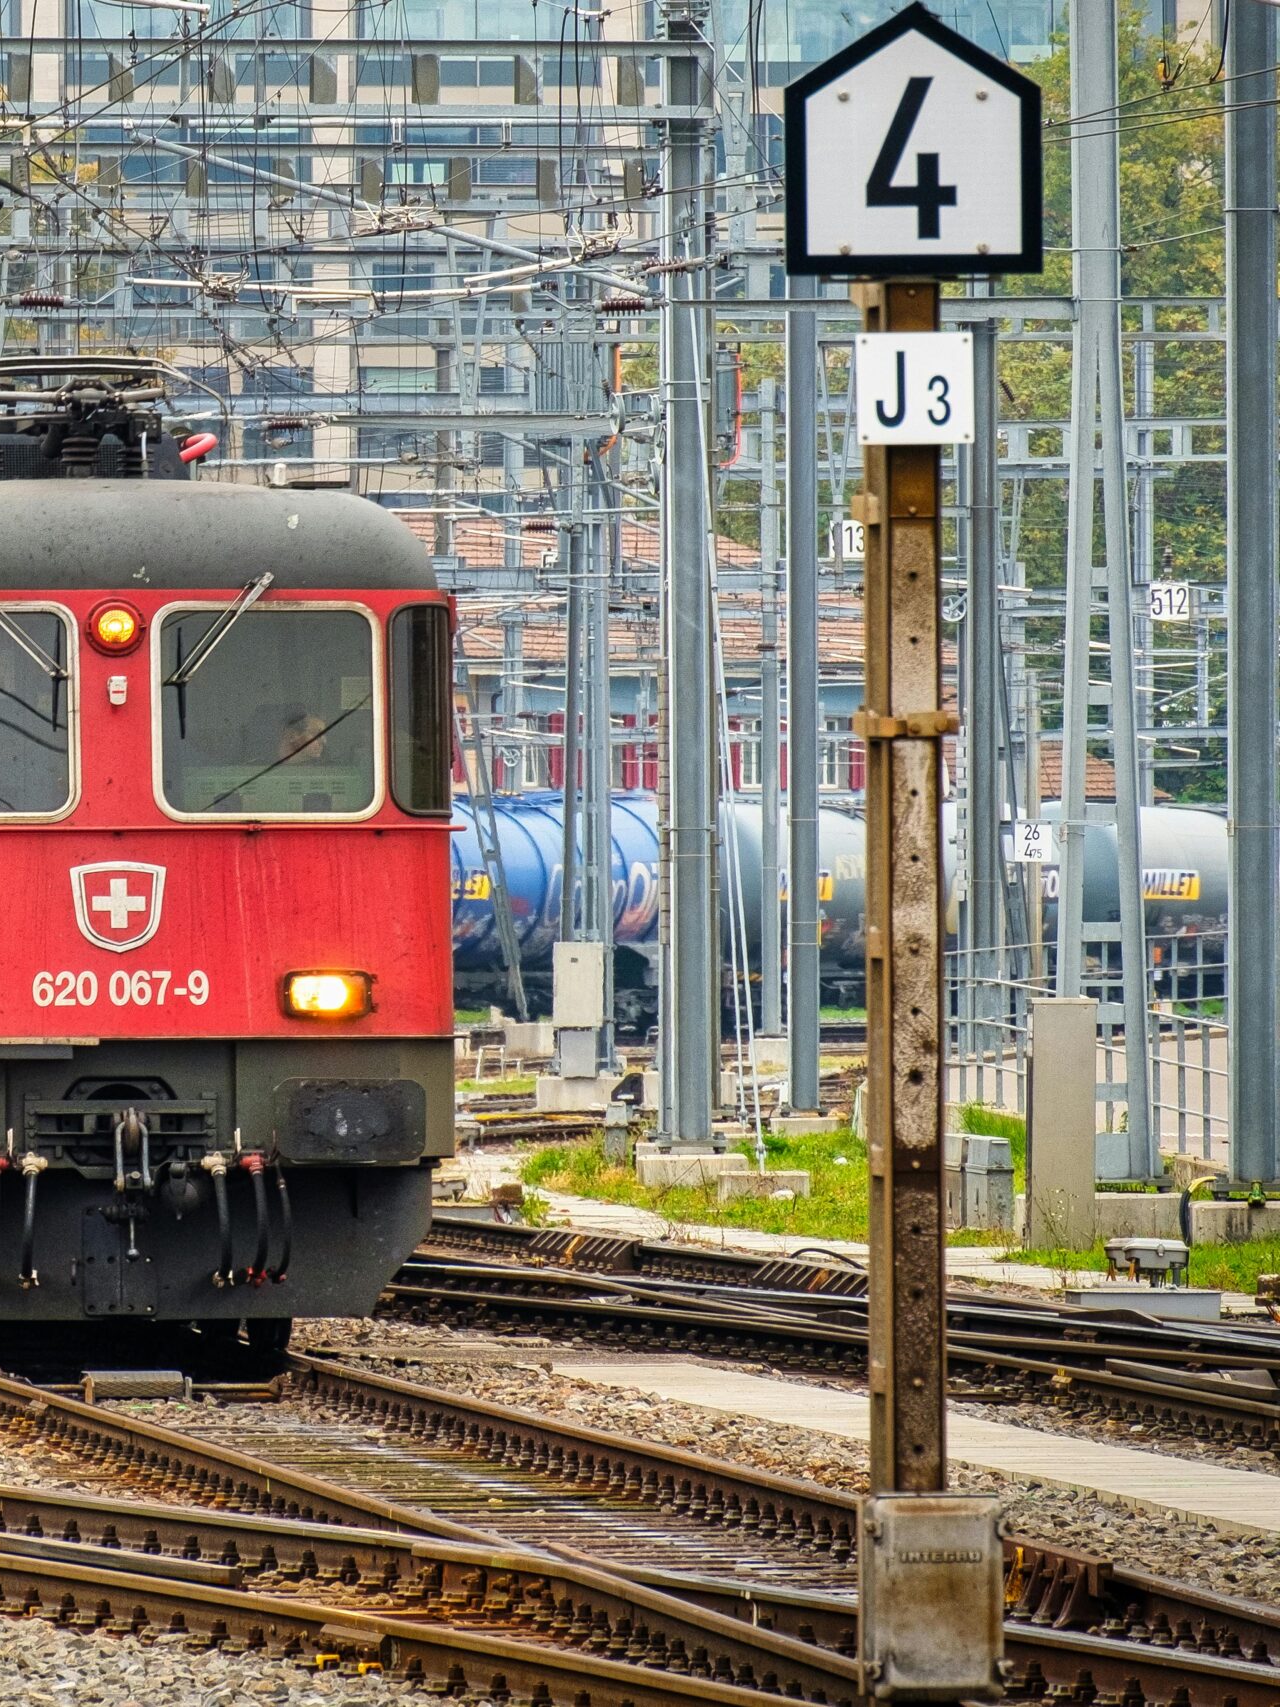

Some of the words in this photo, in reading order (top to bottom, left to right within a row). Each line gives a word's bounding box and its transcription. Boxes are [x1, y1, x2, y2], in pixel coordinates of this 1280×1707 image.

[866, 77, 957, 239] 4
[876, 351, 906, 427] J
[927, 375, 951, 425] 3
[1151, 588, 1187, 615] 512
[1024, 824, 1040, 840] 26
[1024, 843, 1042, 858] 475
[1144, 872, 1196, 897] MILLET
[32, 971, 98, 1007] 620
[108, 970, 210, 1006] 067-9
